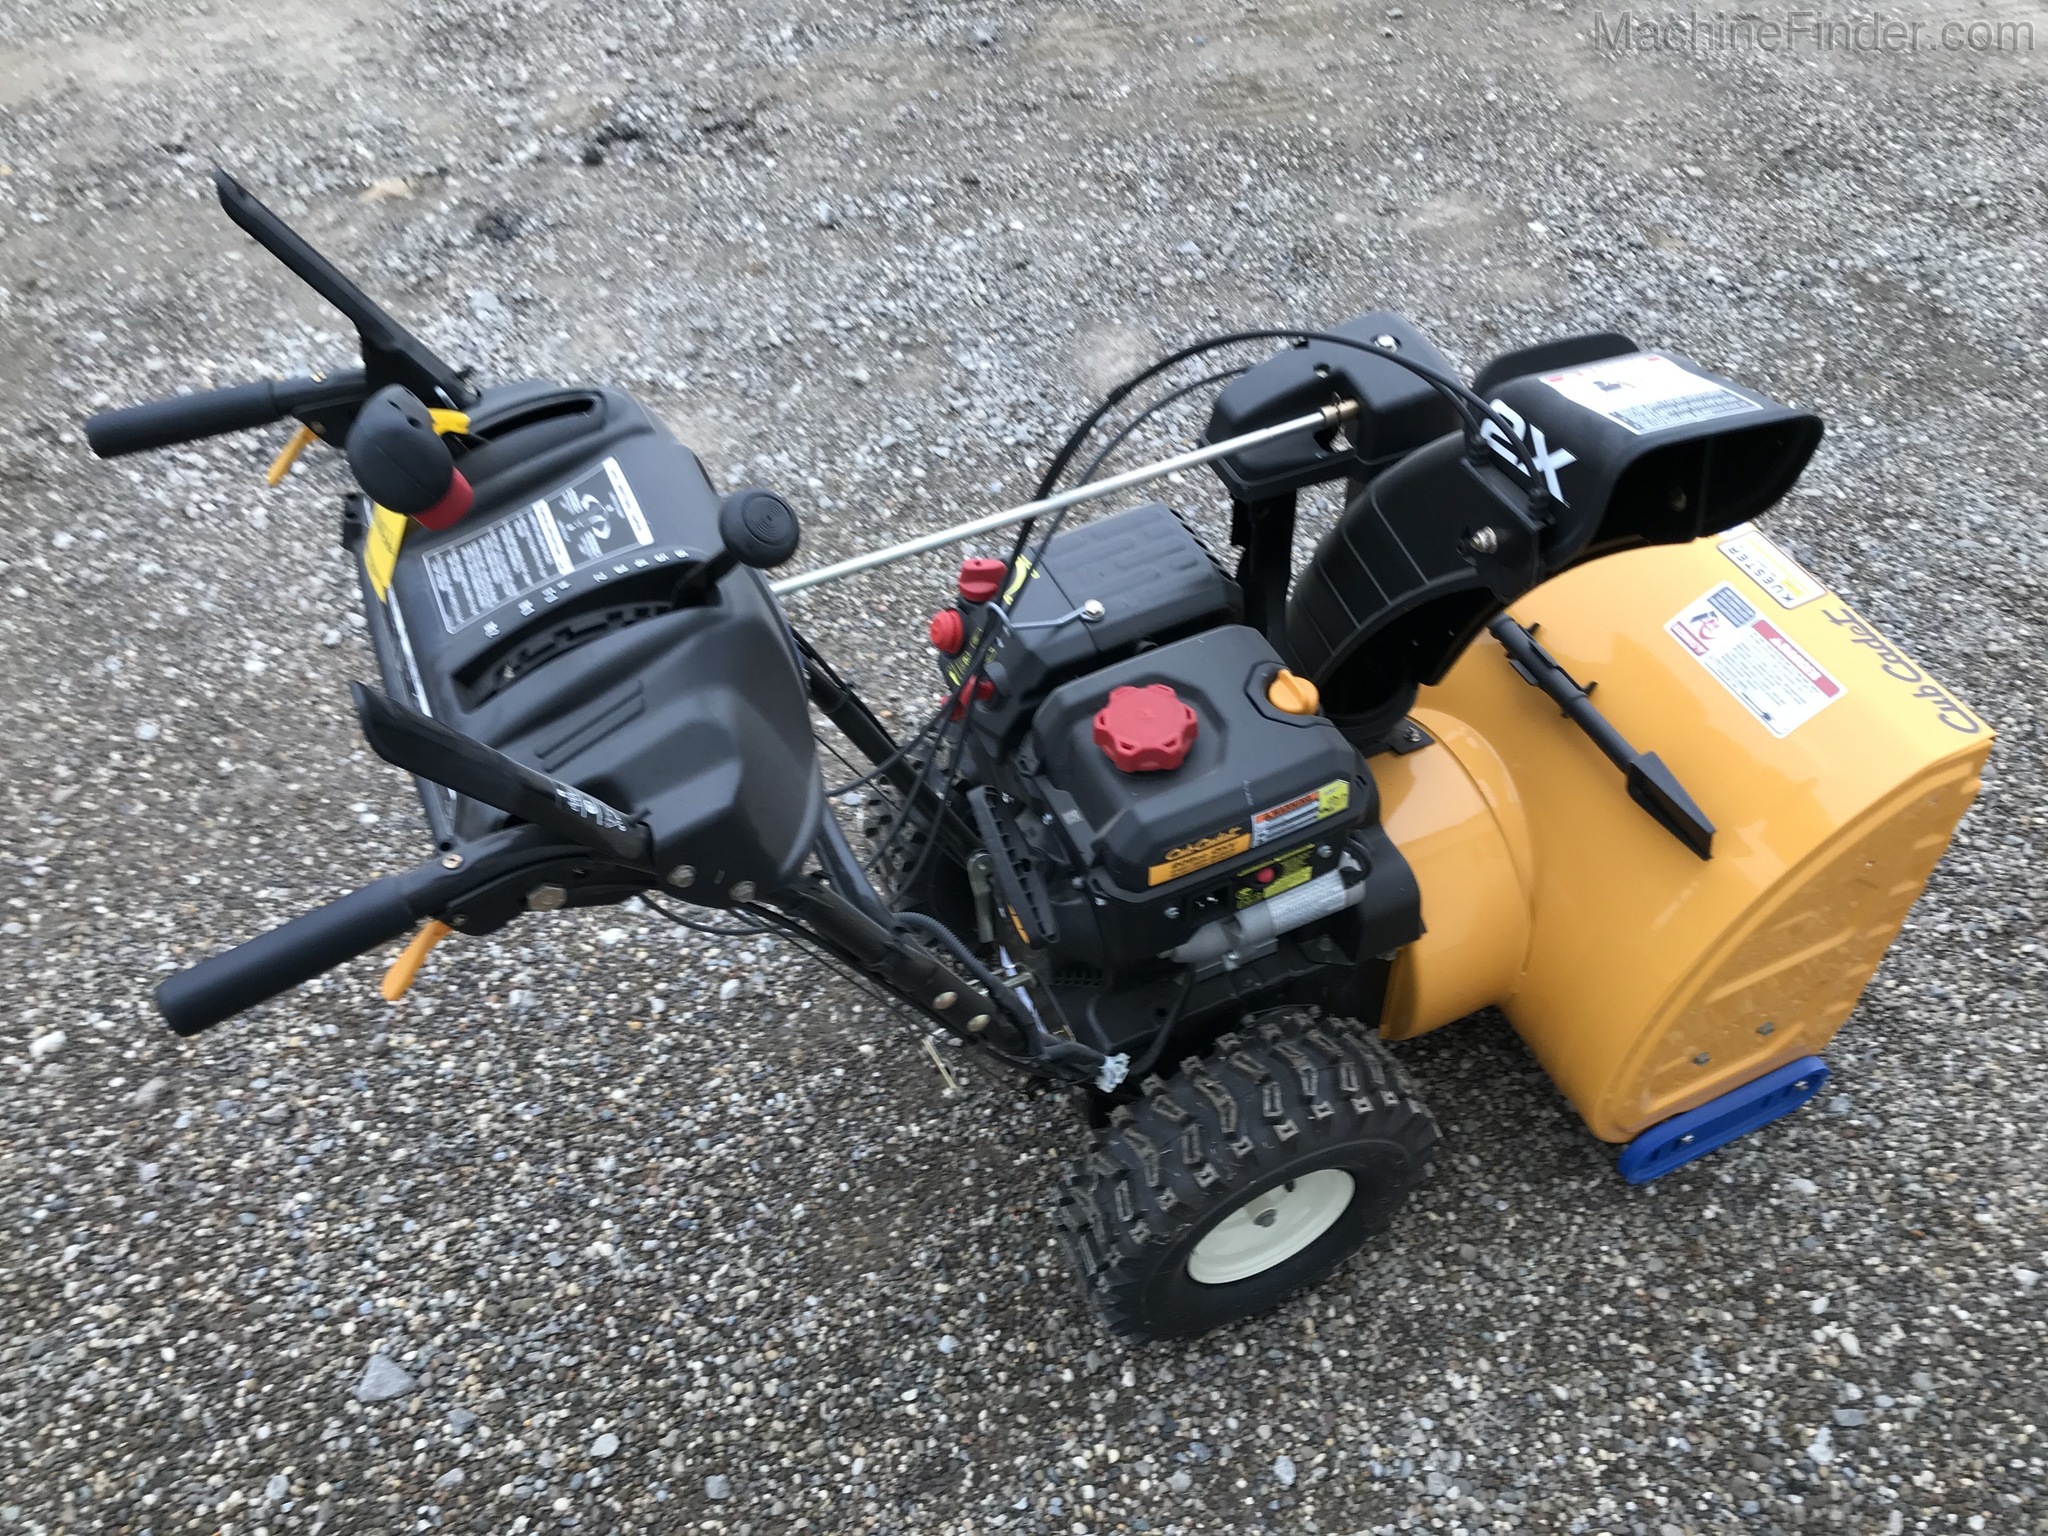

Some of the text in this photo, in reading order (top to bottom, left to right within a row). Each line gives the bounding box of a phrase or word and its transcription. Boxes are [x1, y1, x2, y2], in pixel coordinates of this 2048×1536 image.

[1480, 398, 1577, 507] 2X
[592, 571, 608, 583] 2
[1727, 545, 1795, 603] KUESTER
[1821, 606, 1922, 683] Cadet
[1912, 685, 1980, 734] Cub
